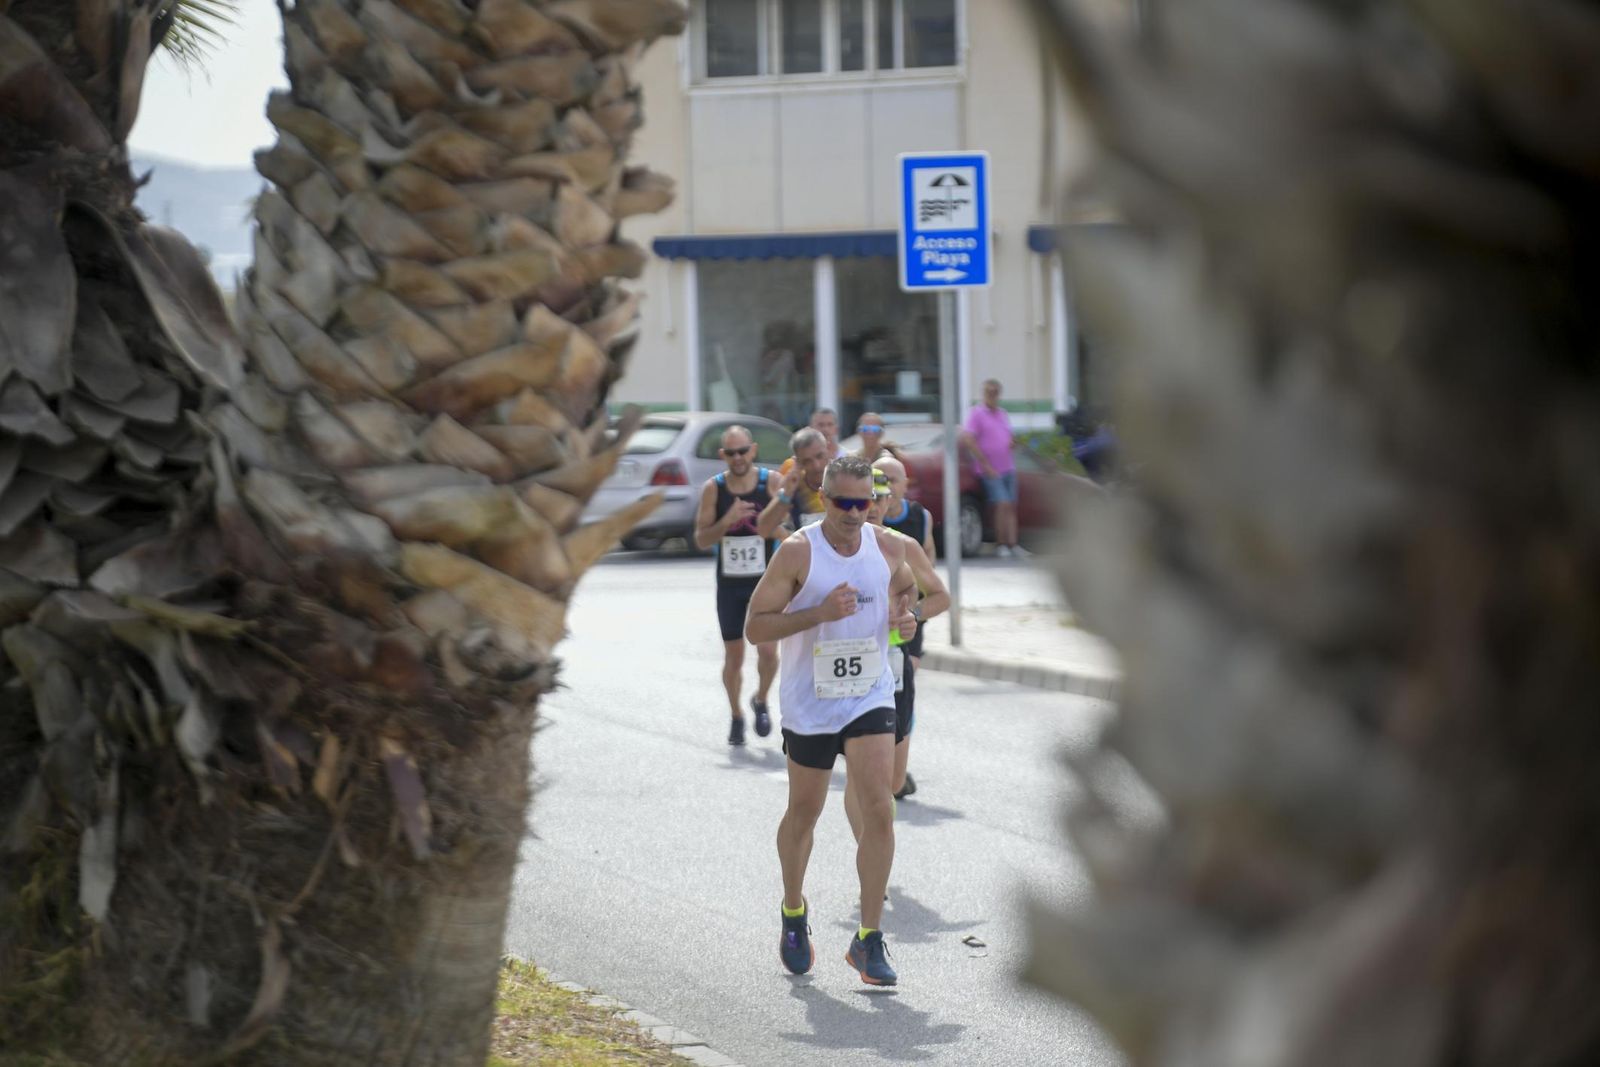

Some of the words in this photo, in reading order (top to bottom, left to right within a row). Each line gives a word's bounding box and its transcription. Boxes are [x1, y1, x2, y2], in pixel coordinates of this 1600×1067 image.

[913, 235, 977, 250] Acceso
[921, 250, 970, 267] Playa
[730, 547, 758, 561] 512
[833, 656, 862, 678] 85
